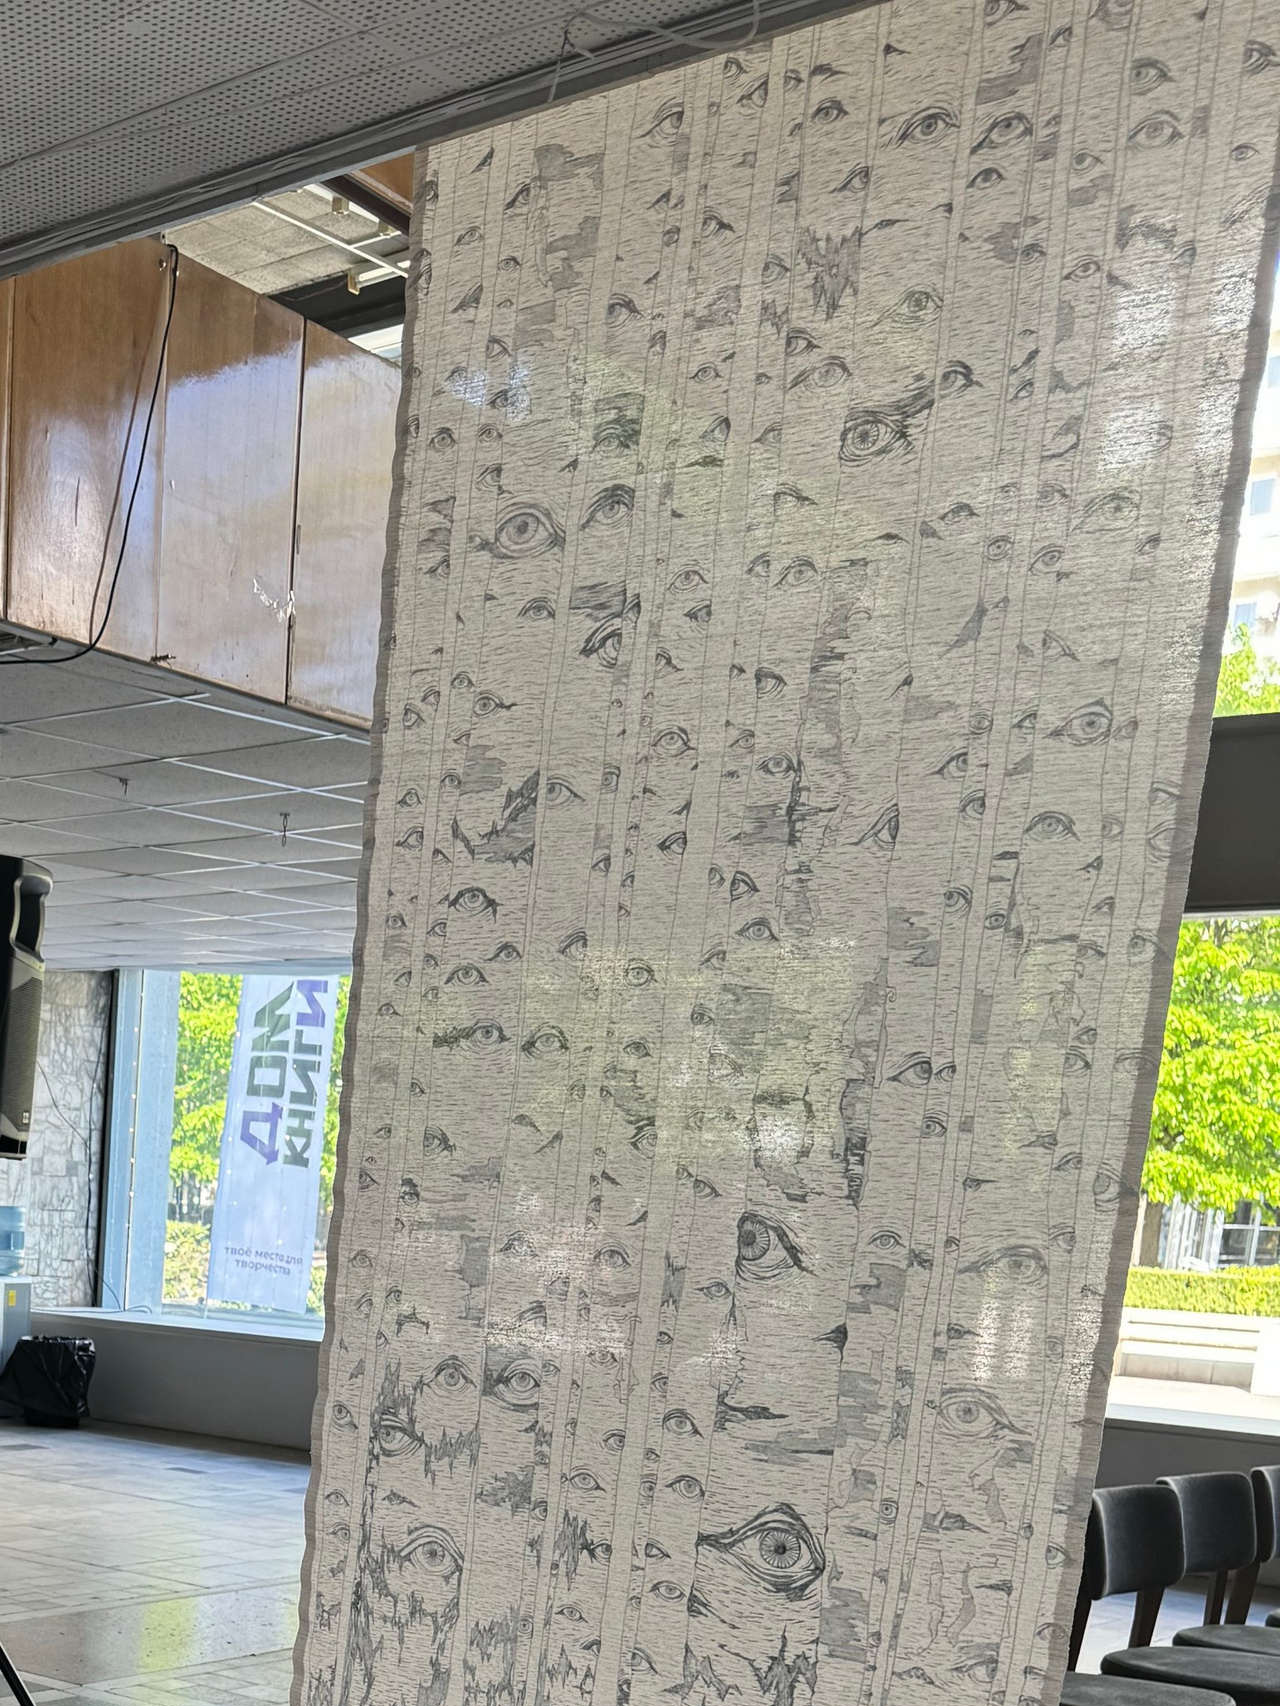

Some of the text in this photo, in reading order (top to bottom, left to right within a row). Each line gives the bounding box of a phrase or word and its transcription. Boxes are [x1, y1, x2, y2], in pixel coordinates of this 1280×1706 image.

[240, 981, 295, 1166] ДОМ
[283, 979, 329, 1168] КНИГИ
[235, 1259, 291, 1275] творчества
[255, 1250, 285, 1262] место
